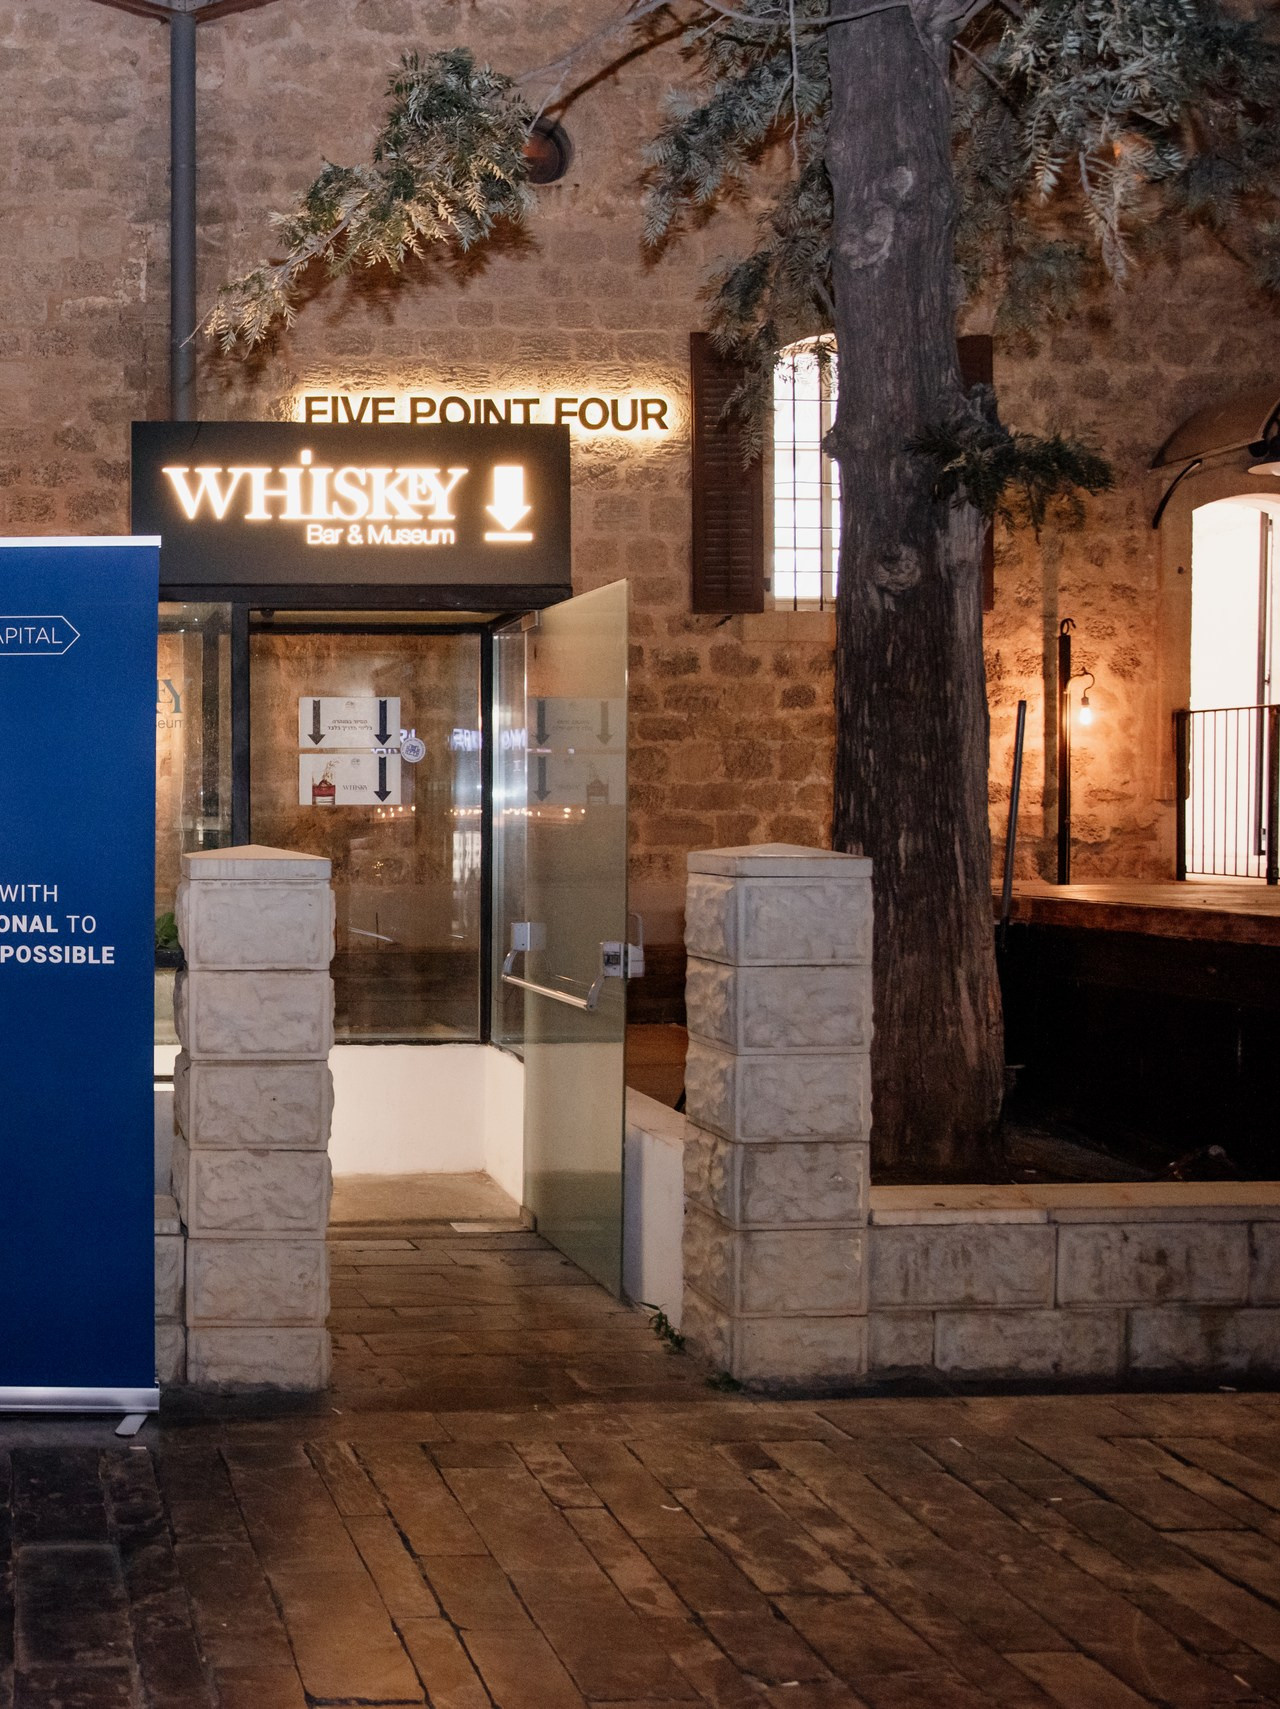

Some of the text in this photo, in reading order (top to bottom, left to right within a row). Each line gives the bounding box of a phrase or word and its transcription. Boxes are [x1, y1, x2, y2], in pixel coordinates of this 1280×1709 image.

[304, 396, 670, 431] FIVE POINT FOUR
[161, 449, 470, 521] WHISKEY
[306, 524, 456, 545] Bar & Museum
[66, 915, 97, 933] TO
